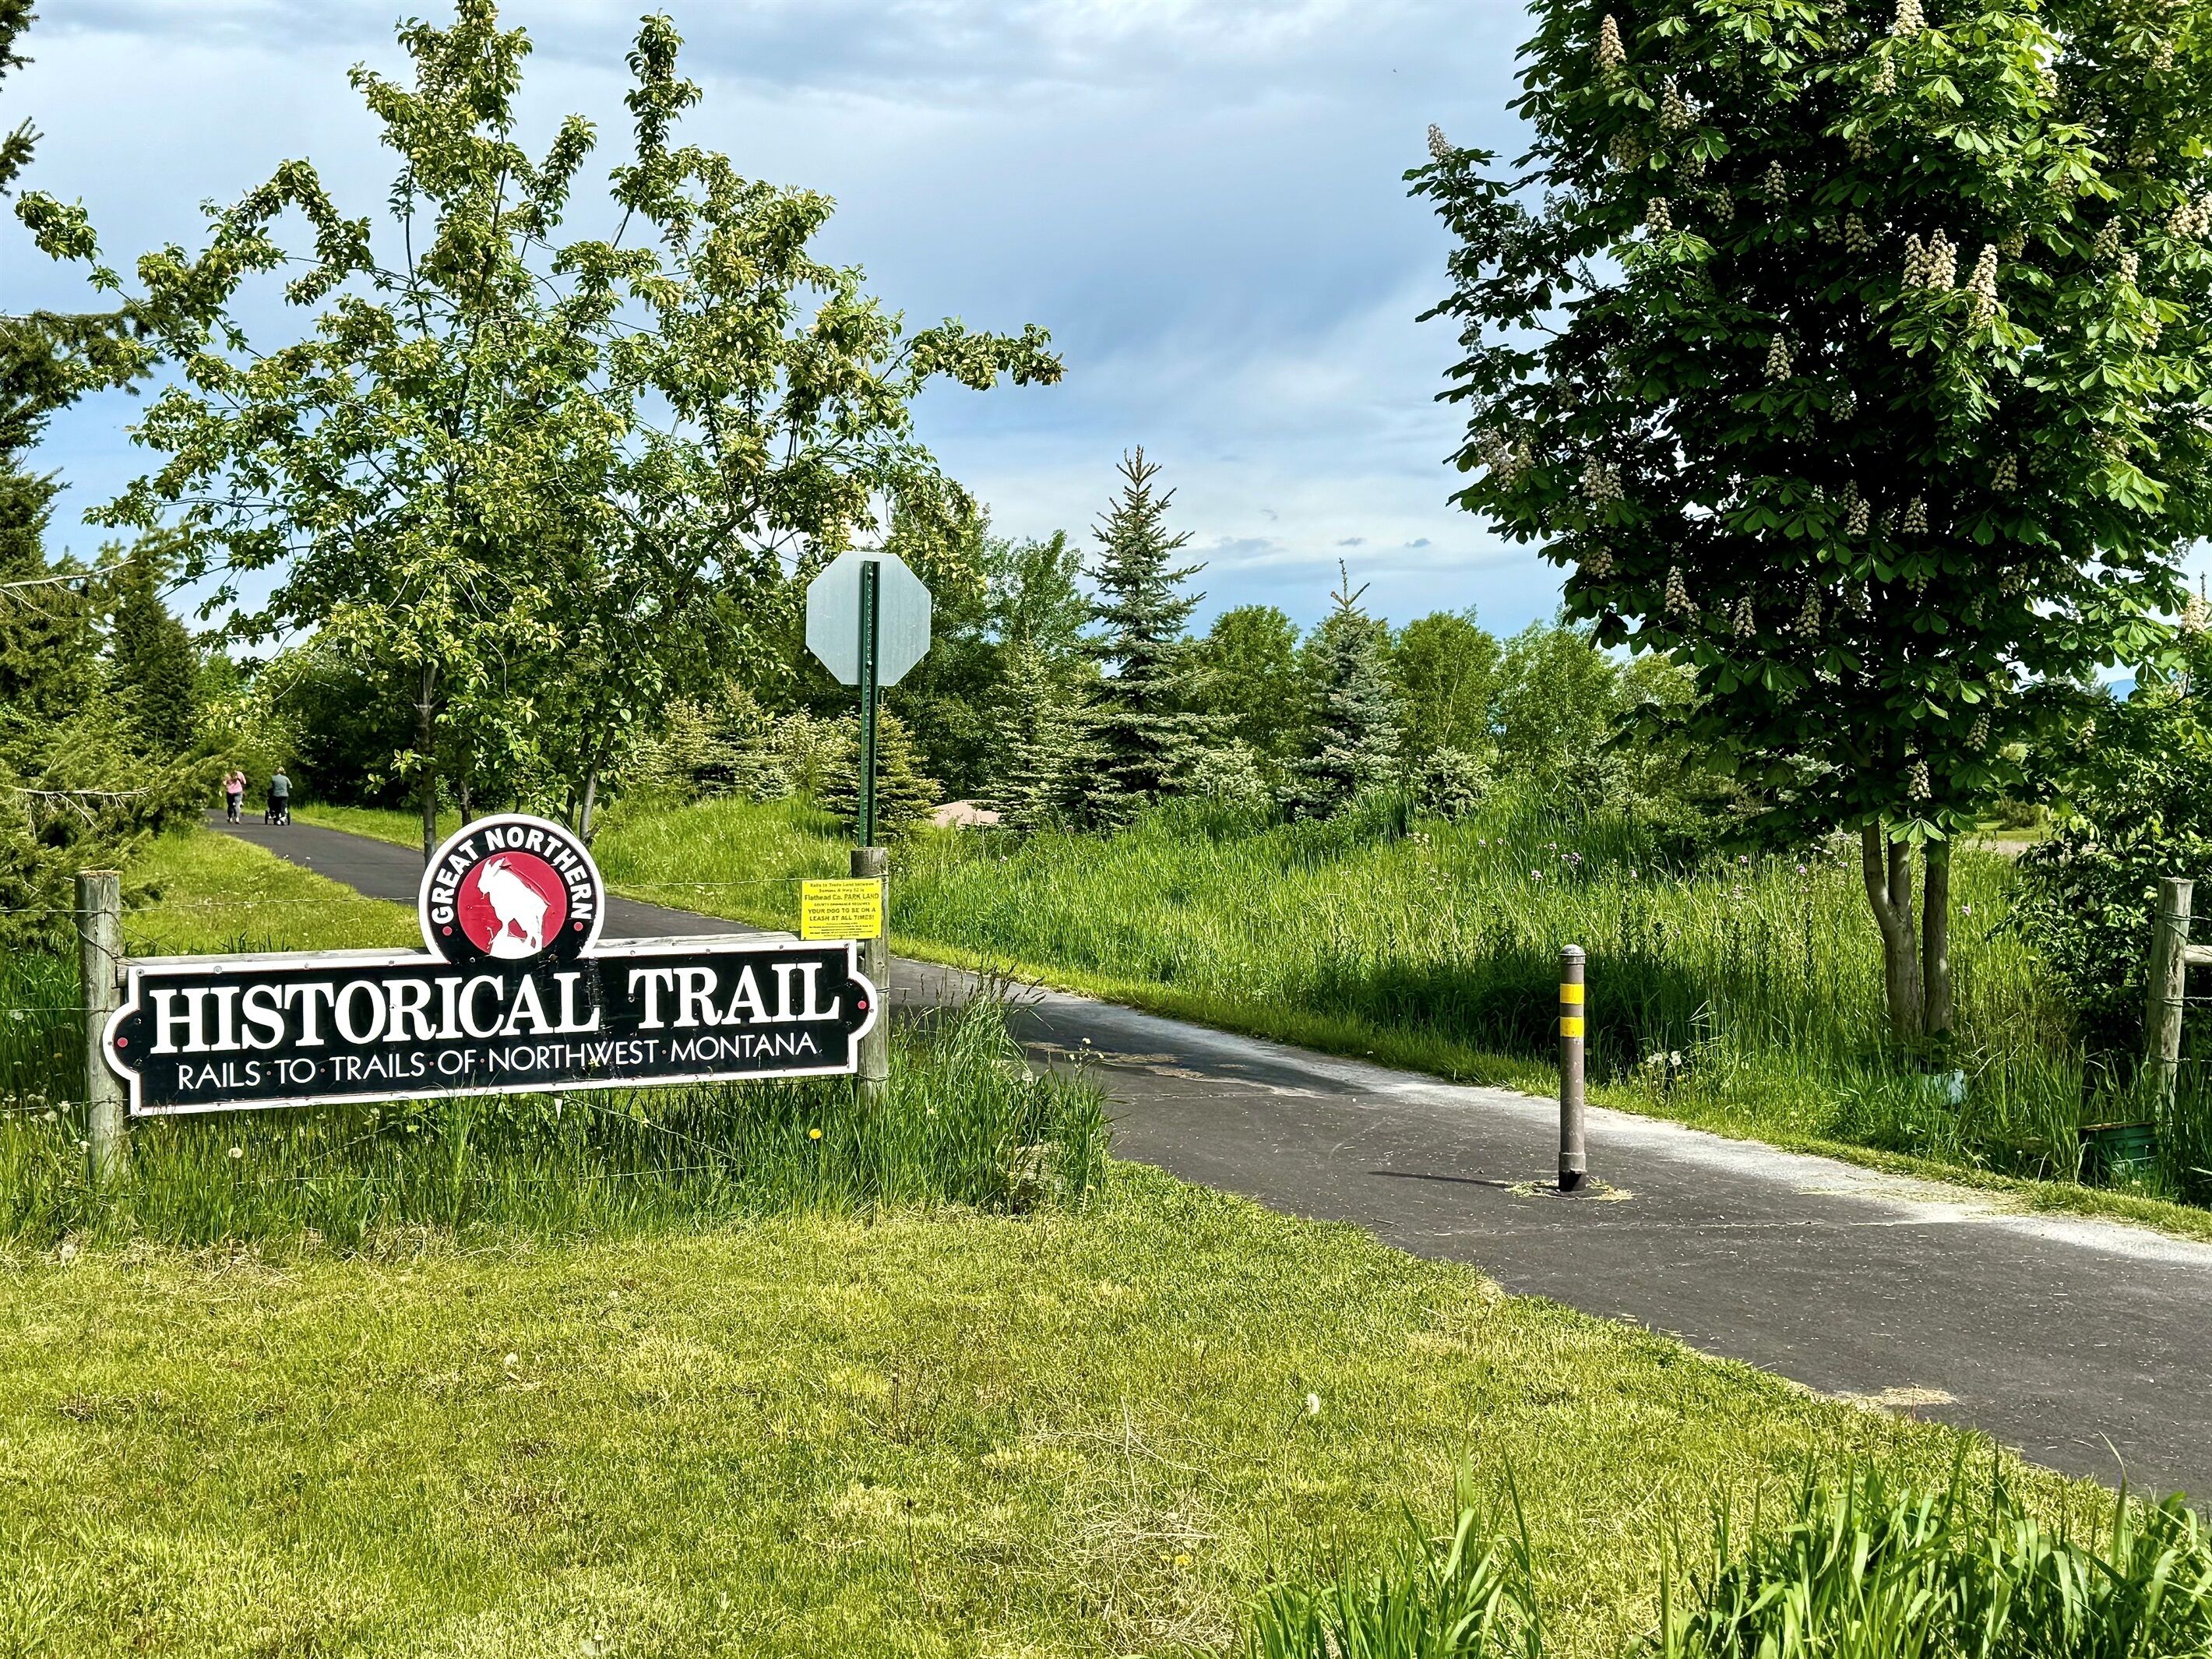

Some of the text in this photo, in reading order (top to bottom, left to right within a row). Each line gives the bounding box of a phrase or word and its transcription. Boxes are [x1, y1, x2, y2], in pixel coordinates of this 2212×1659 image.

[431, 826, 594, 925] GREAT NORTHERN
[149, 962, 840, 1055] HISTORICAL TRAIL
[177, 1032, 818, 1090] RAILS TO TRAILS OF NORTHWEST MONTANA
